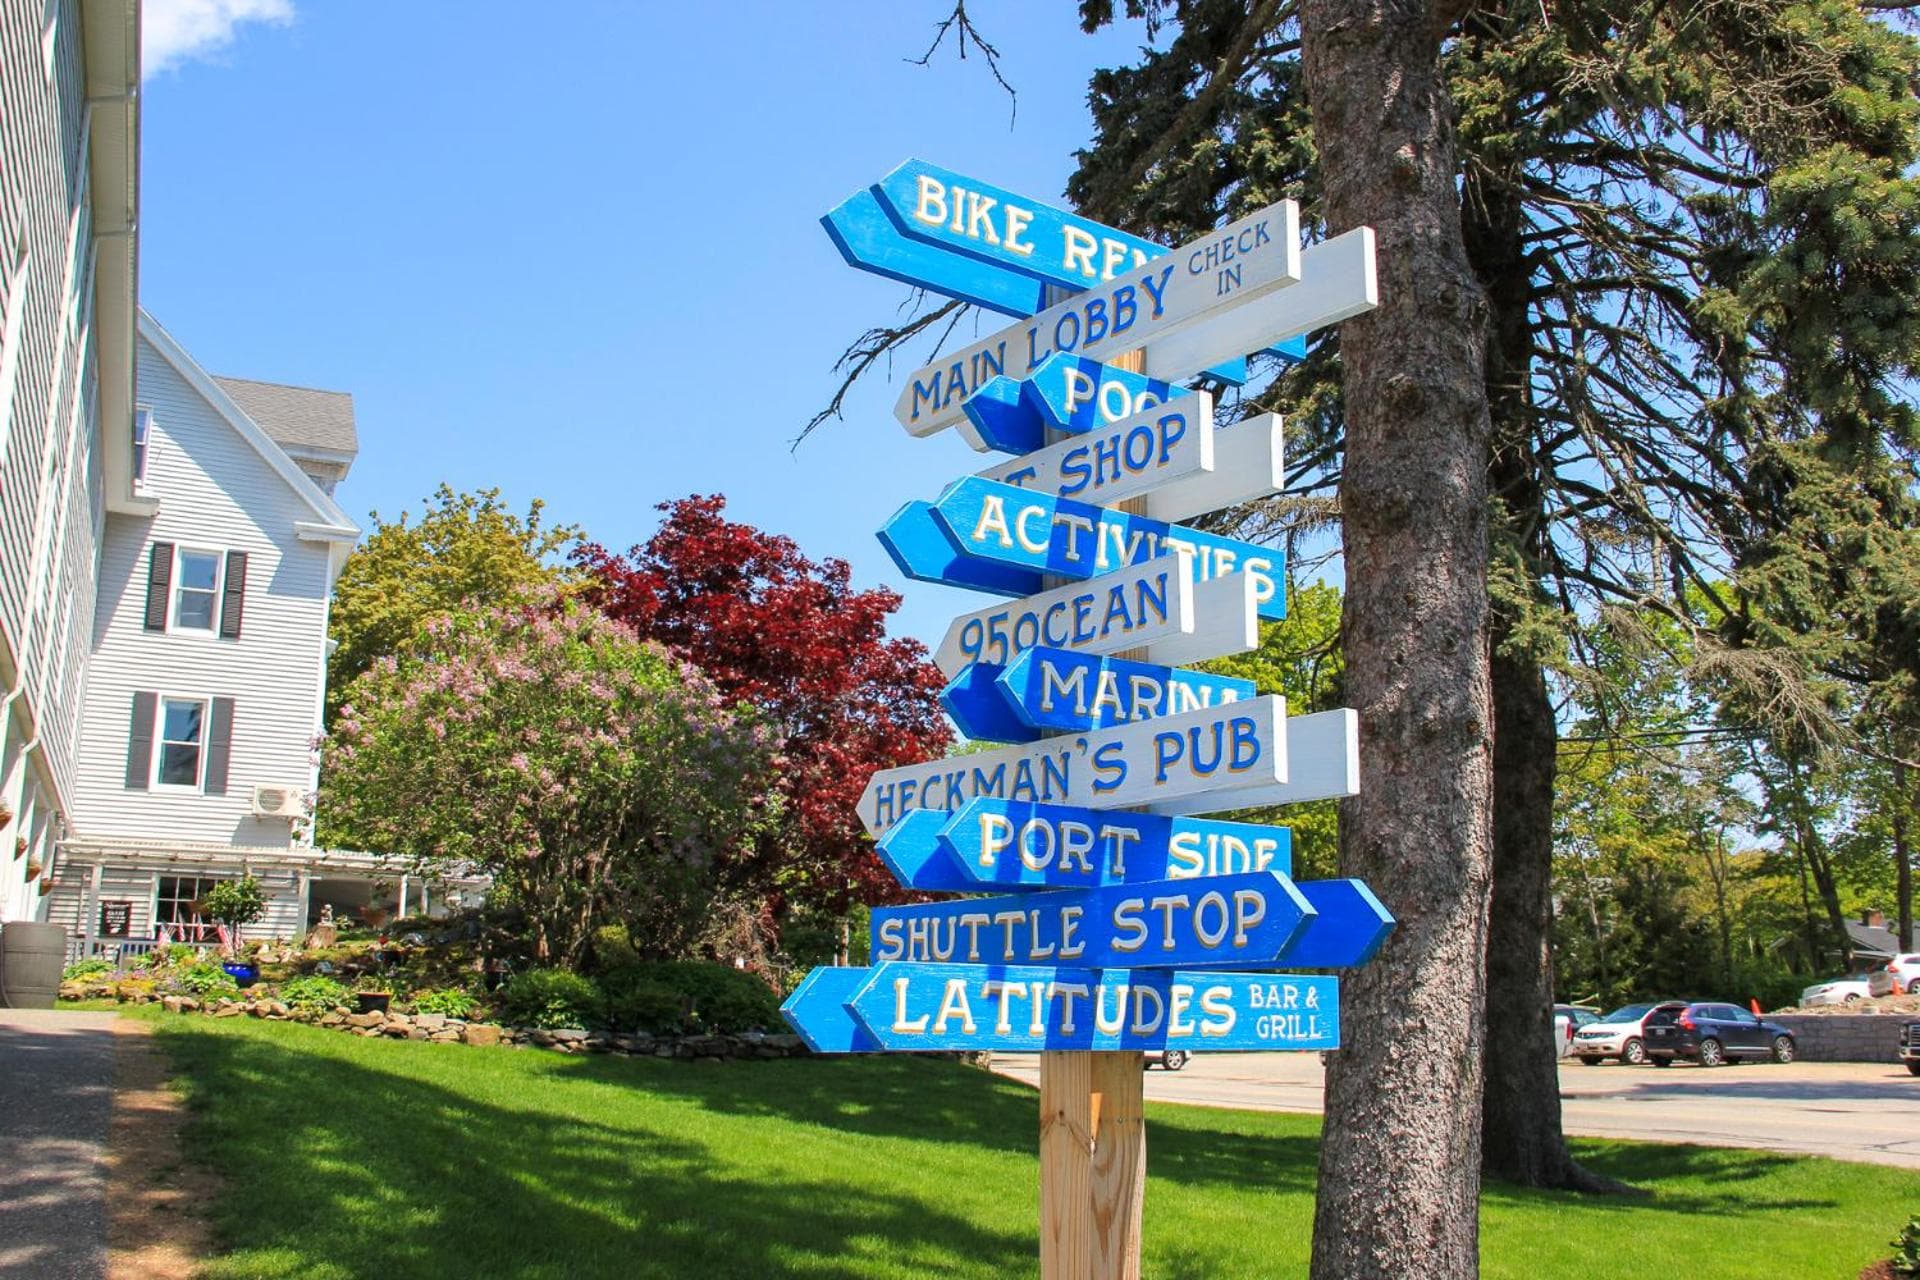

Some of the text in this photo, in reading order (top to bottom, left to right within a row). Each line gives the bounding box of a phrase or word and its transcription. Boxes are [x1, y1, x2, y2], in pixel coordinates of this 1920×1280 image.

[914, 174, 1035, 255] BIKE
[1188, 220, 1270, 275] CHECK
[1216, 263, 1242, 297] IN
[910, 264, 1175, 422] MAIN LOBBY
[1058, 413, 1187, 499] SHOP
[874, 717, 1261, 830] HECKMAN'S PUB
[980, 812, 1278, 880] PORT SIDE
[877, 890, 1267, 962] SHUTTLE STOP
[892, 977, 1237, 1037] LATITUDES
[1249, 983, 1320, 1010] BAR &
[1256, 1014, 1322, 1039] GRILL
